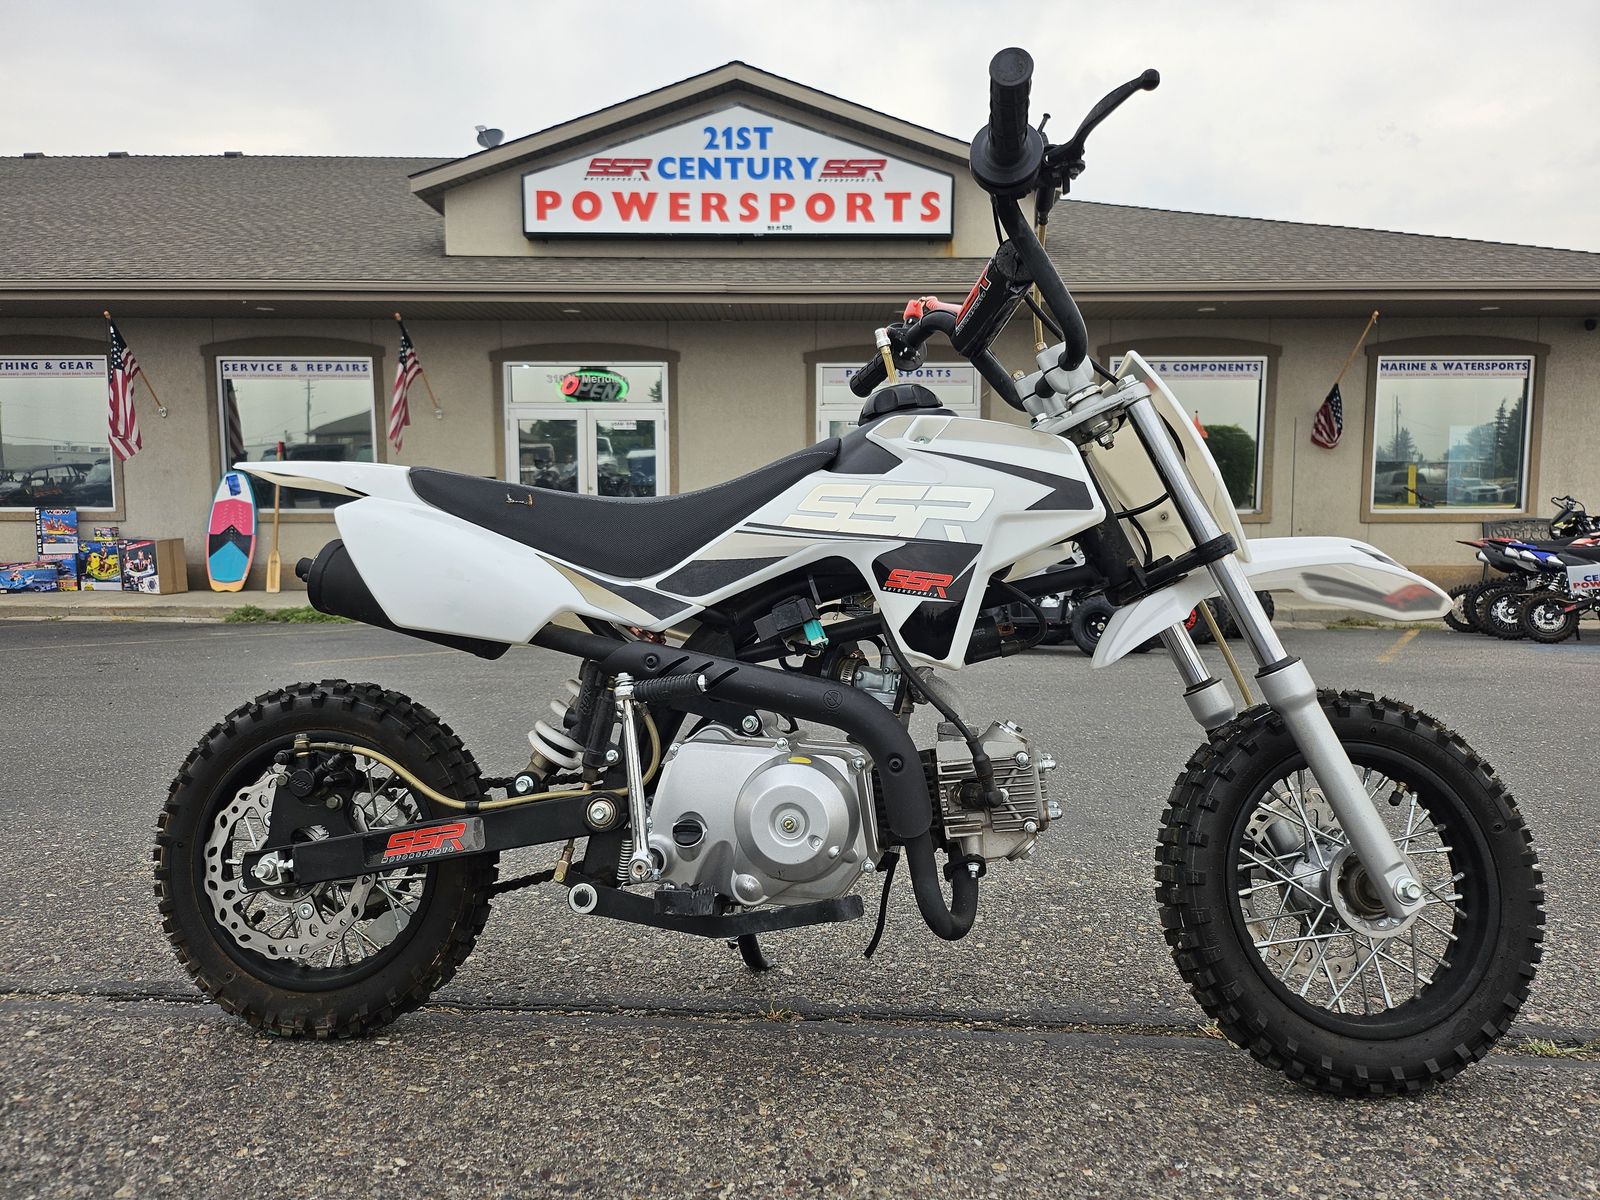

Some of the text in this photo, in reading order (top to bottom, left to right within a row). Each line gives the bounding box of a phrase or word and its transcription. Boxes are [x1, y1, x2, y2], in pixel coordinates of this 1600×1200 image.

[703, 126, 773, 151] 21ST
[586, 158, 653, 181] SSR
[657, 156, 819, 181] CENTURY
[820, 159, 887, 182] SSR
[535, 190, 941, 223] POWERSPORTS
[45, 361, 53, 370] &
[59, 361, 94, 370] GEAR
[224, 363, 369, 372] SERVICE & REPAIRS
[1159, 363, 1167, 372] &
[1173, 363, 1259, 372] COMPONENTS
[1380, 361, 1528, 371] MARINE & WATERSPORTS
[561, 374, 620, 401] OPEN
[782, 484, 995, 543] SSR
[884, 568, 954, 598] SSR
[383, 822, 467, 858] SSR
